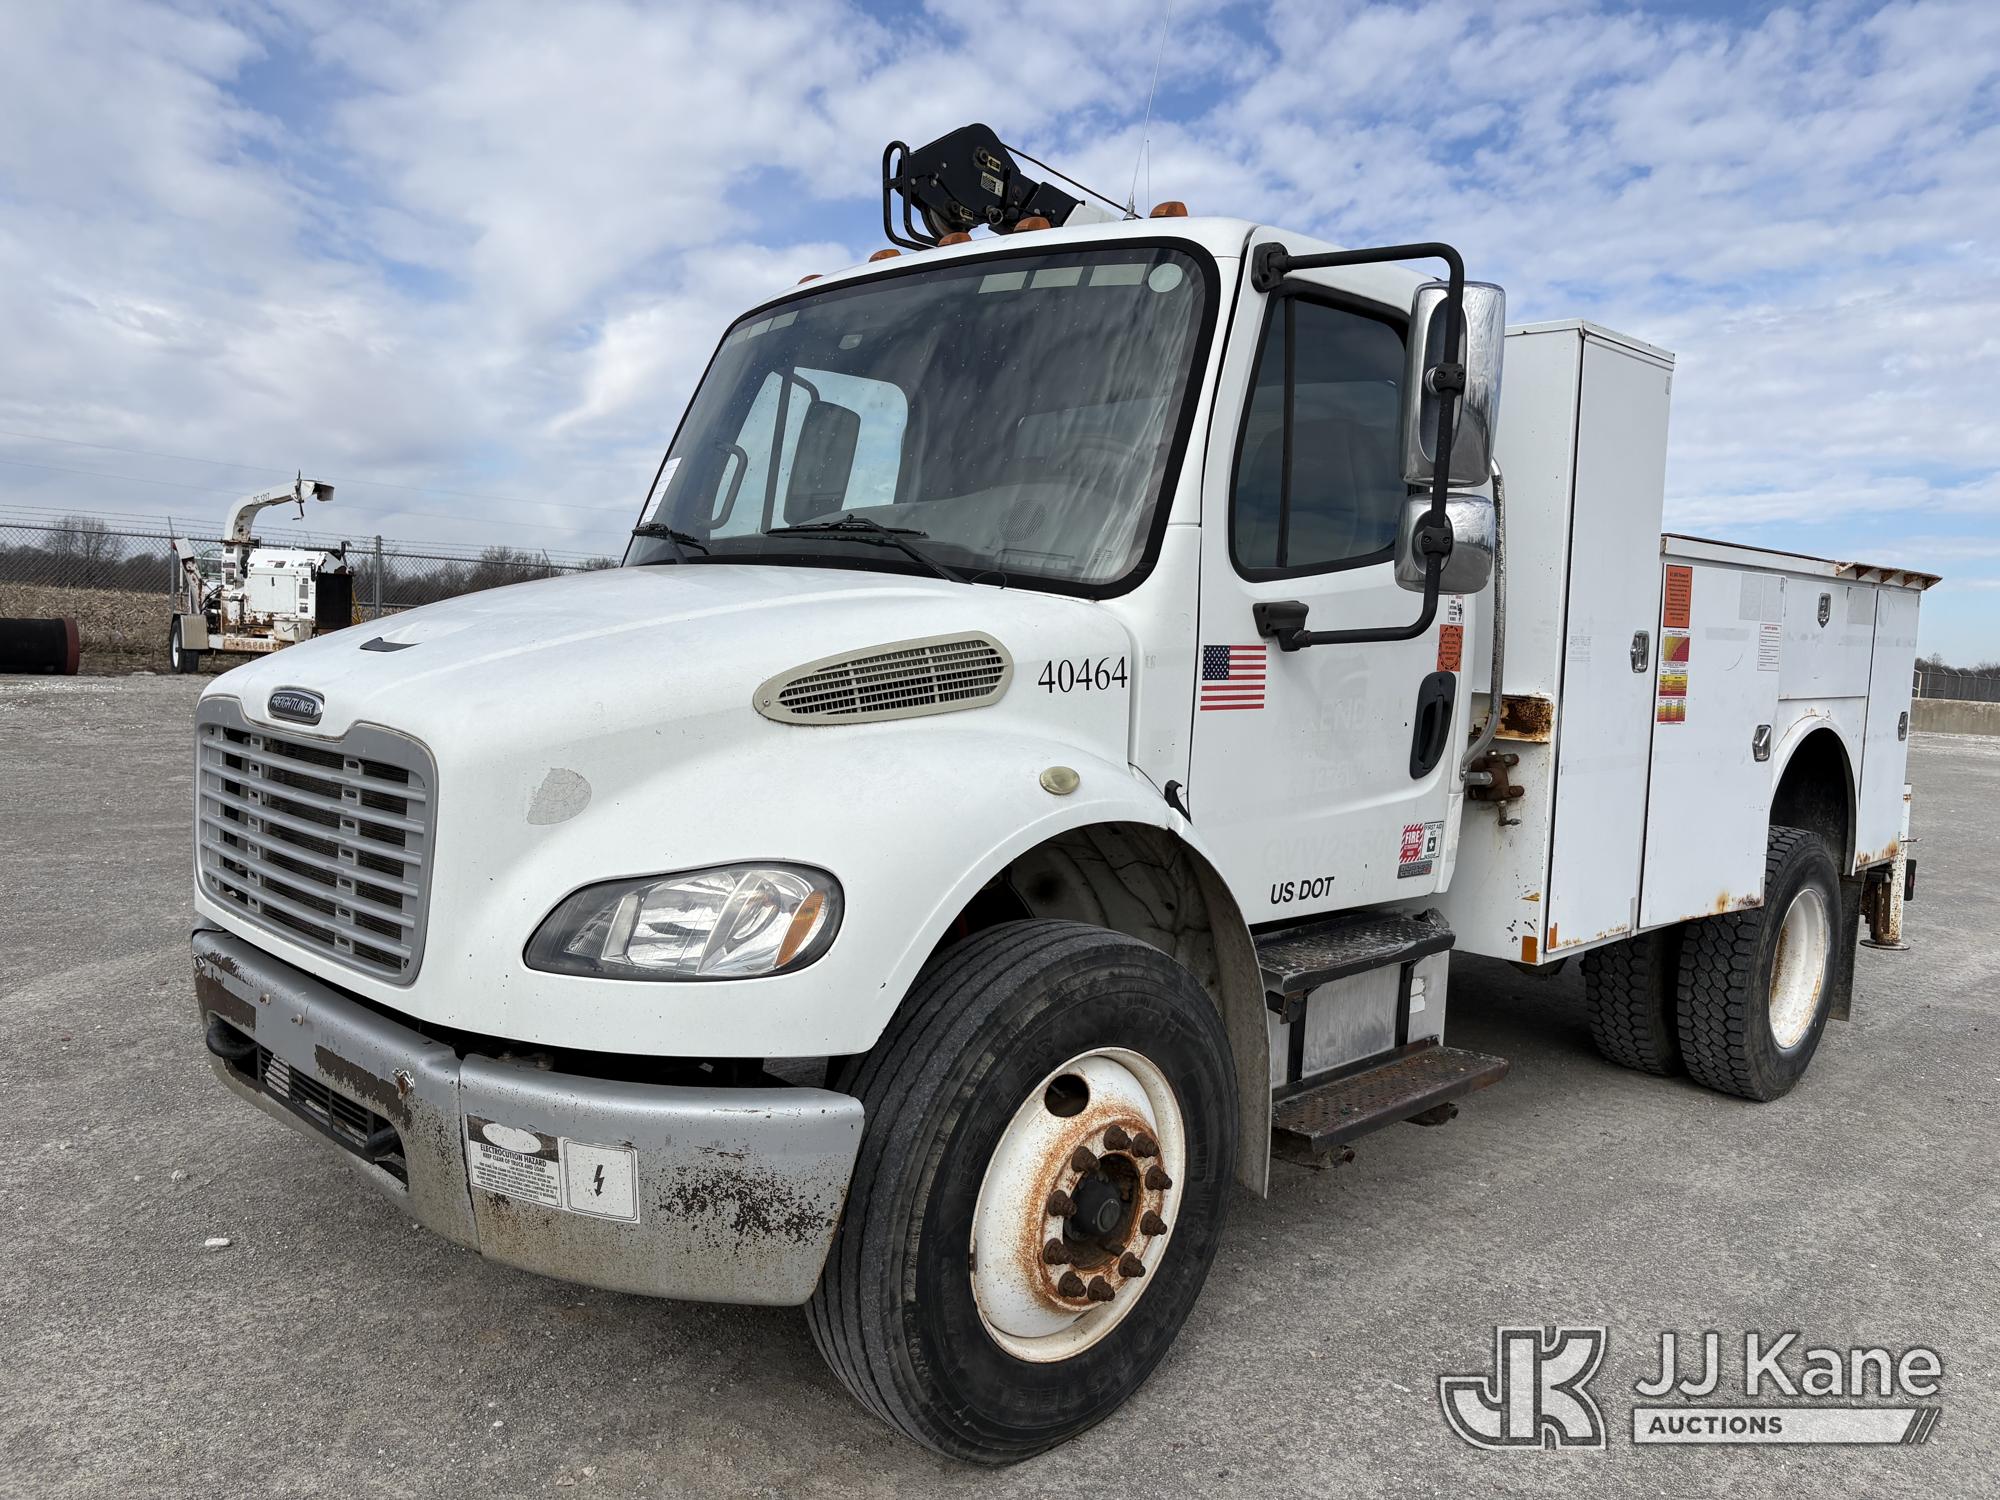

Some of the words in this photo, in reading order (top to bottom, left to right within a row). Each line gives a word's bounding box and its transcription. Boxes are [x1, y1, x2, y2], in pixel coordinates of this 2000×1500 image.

[1038, 656, 1128, 693] 40464
[271, 696, 315, 715] FREIGHTLINER
[1405, 830, 1420, 844] FIRE
[1270, 881, 1295, 904] US
[1298, 876, 1335, 900] DOT
[480, 1143, 523, 1161] ELECTROCUTION
[523, 1155, 547, 1167] HAZARD
[511, 1159, 524, 1167] TRUCK
[524, 1162, 534, 1170] AND
[534, 1164, 546, 1173] LOAD
